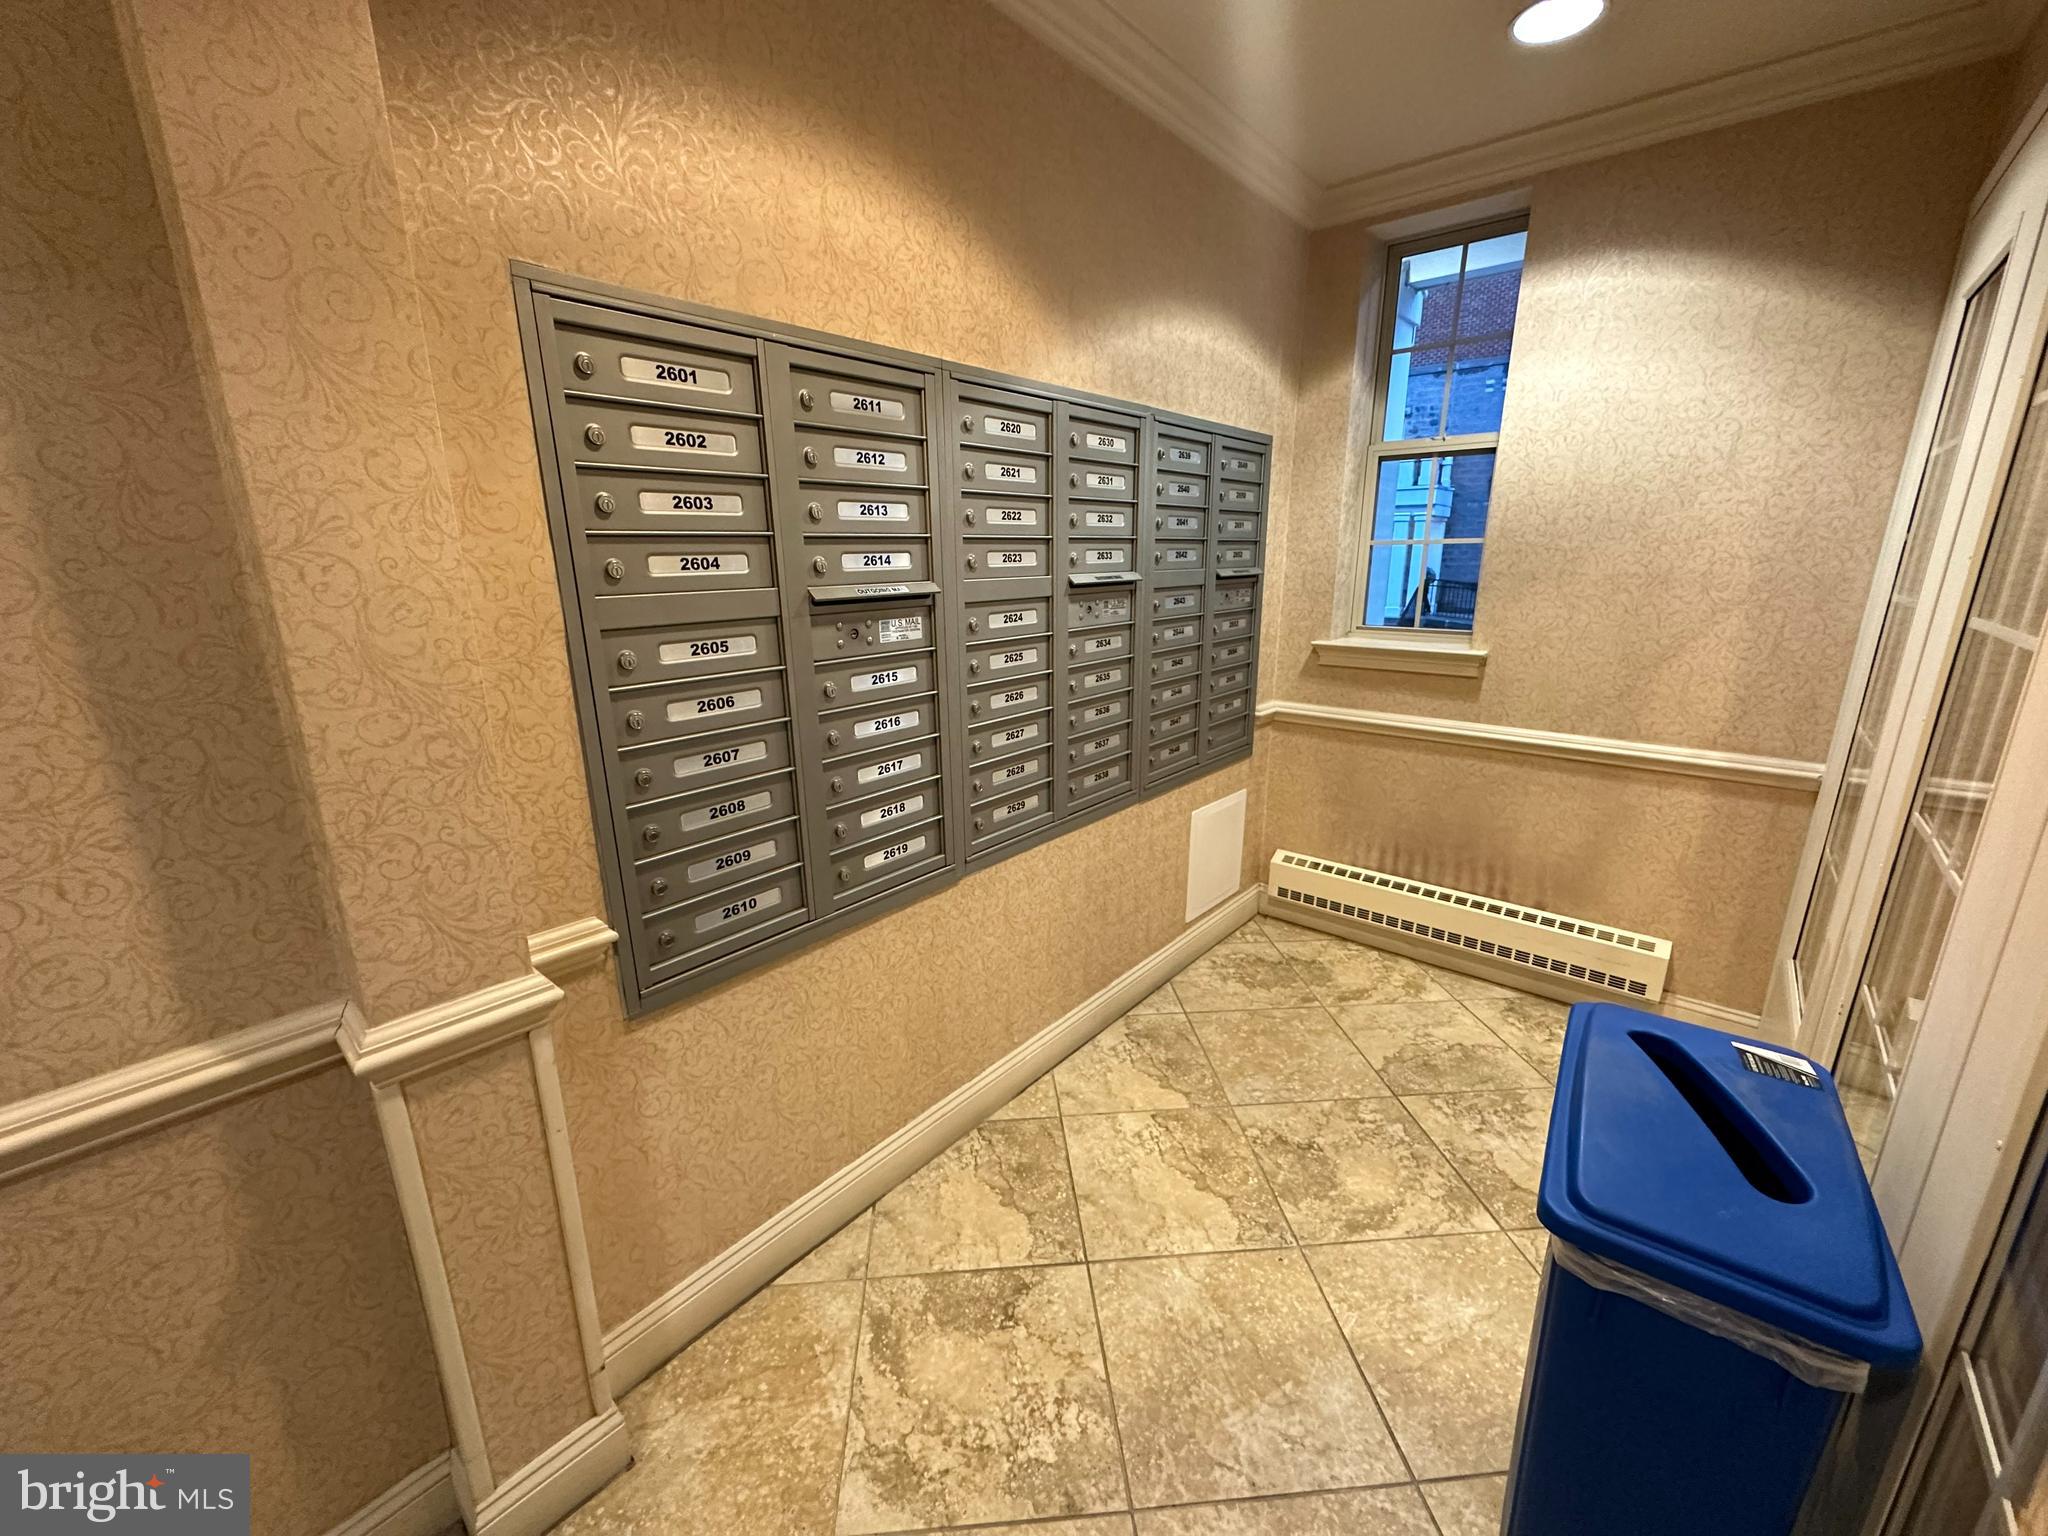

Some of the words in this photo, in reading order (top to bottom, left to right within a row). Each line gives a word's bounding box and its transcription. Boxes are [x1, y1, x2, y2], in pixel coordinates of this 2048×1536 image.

[656, 364, 698, 385] 2601
[854, 397, 882, 413] 2611
[1001, 422, 1021, 434] 2620
[665, 432, 707, 449] 2602
[1098, 437, 1114, 448] 2630
[856, 452, 885, 465] 2612
[1001, 467, 1020, 478] 2621
[1098, 476, 1113, 485] 2631
[672, 496, 713, 510] 2603
[860, 504, 888, 517] 2613
[1002, 511, 1021, 521] 2622
[1098, 514, 1112, 523] 2632
[863, 554, 891, 566] 2614
[1002, 553, 1022, 563] 2623
[1097, 552, 1112, 560] 2633
[680, 556, 720, 571] 2604
[905, 617, 920, 625] MAIL
[1004, 613, 1023, 623] 2624
[690, 641, 729, 655] 2605
[1096, 639, 1111, 648] 2634
[1004, 652, 1023, 663] 2625
[871, 672, 898, 685] 2615
[1095, 673, 1110, 682] 2635
[1005, 691, 1024, 702] 2626
[697, 696, 735, 713] 2606
[1095, 706, 1109, 715] 2636
[874, 716, 900, 730] 2616
[1006, 729, 1024, 740] 2627
[1095, 739, 1109, 749] 2637
[703, 749, 740, 767] 2607
[878, 760, 903, 775] 2617
[1006, 765, 1024, 777] 2628
[709, 800, 745, 819] 2608
[880, 803, 905, 818] 2618
[1007, 801, 1025, 813] 2629
[883, 844, 908, 859] 2619
[716, 850, 751, 870] 2609
[722, 899, 757, 918] 2610
